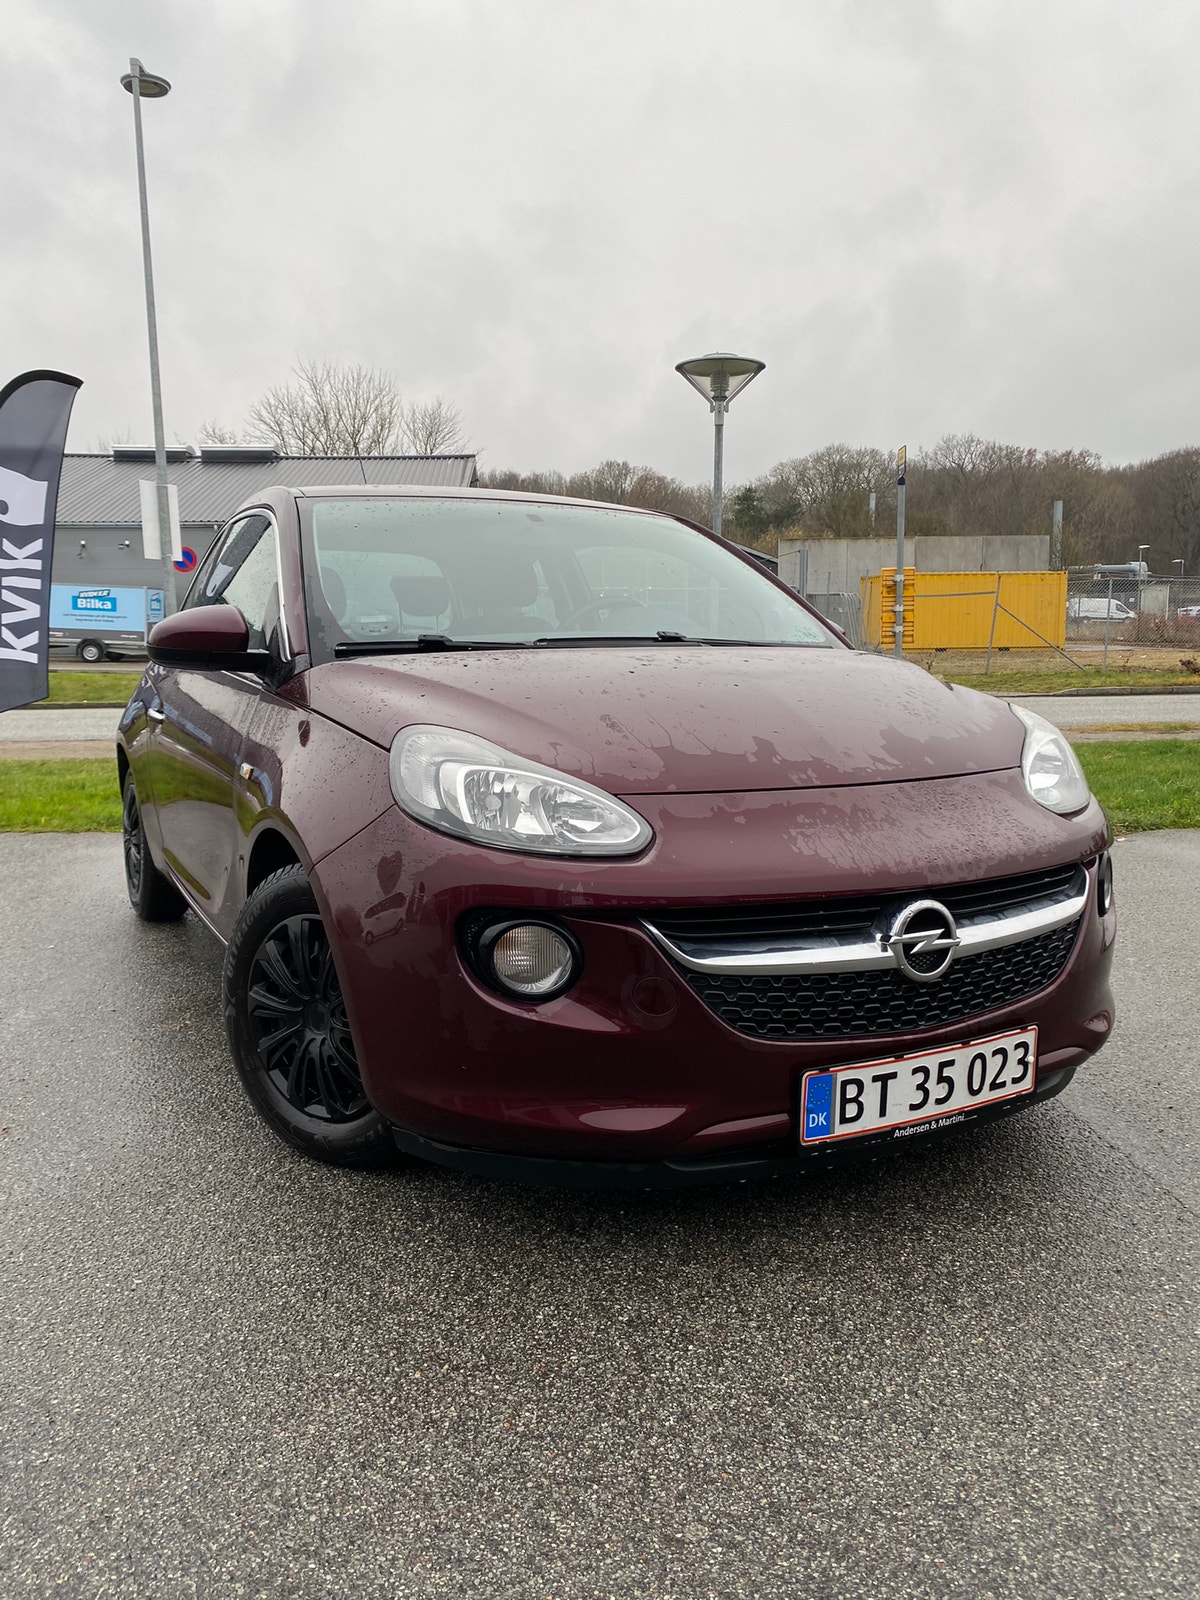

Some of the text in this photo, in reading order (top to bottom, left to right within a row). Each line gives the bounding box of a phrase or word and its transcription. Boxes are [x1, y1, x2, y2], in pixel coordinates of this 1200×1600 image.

[0, 538, 43, 664] kvik
[77, 598, 112, 610] Bilka
[839, 1041, 1030, 1125] BT 35 023
[809, 1111, 827, 1128] DK
[893, 1113, 965, 1138] Andersen & Martini
